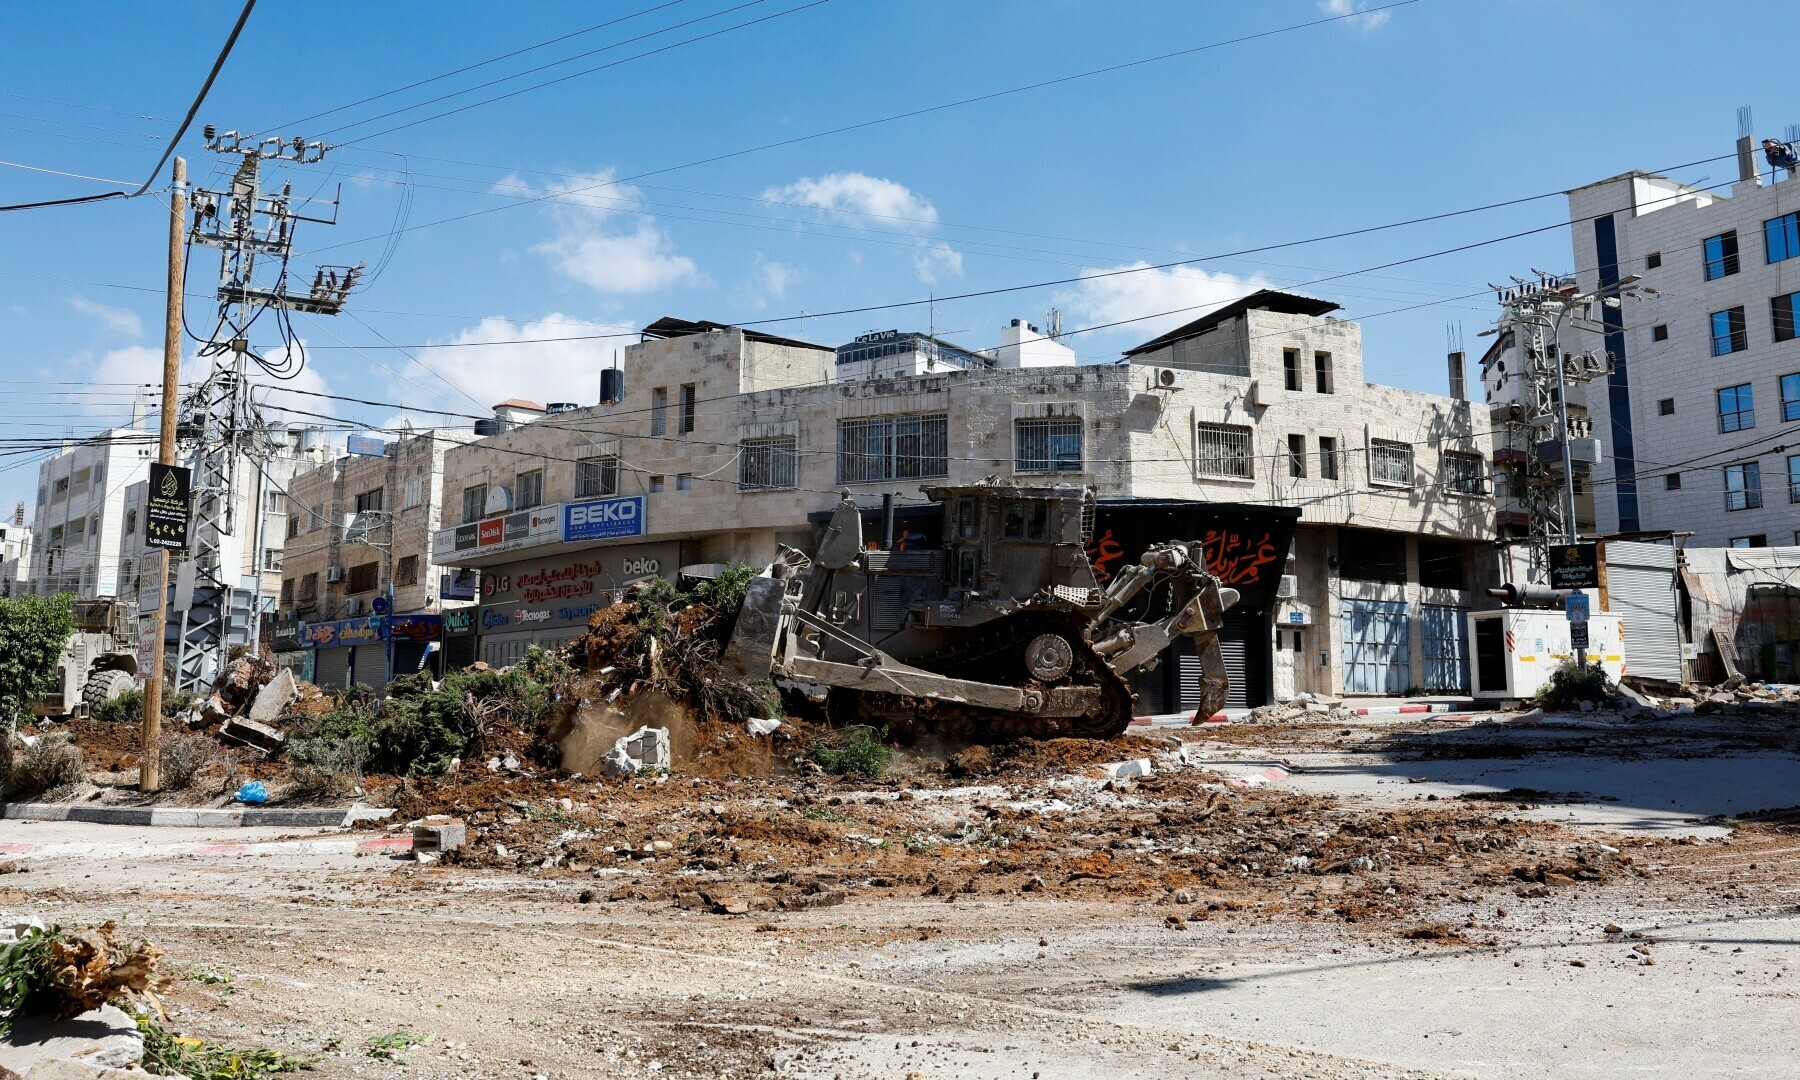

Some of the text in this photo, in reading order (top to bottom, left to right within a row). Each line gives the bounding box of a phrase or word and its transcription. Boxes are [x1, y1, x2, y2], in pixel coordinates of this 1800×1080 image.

[570, 501, 636, 526] BEKO
[480, 526, 500, 538] SanDisk
[592, 520, 635, 528] APPLIANCES
[575, 560, 601, 578] شركة
[623, 557, 658, 574] beko
[142, 573, 160, 588] BEAUTY
[496, 576, 508, 593] LG
[445, 609, 470, 631] Quick
[521, 610, 550, 622] Tecnogas
[276, 623, 296, 638] مؤسسة
